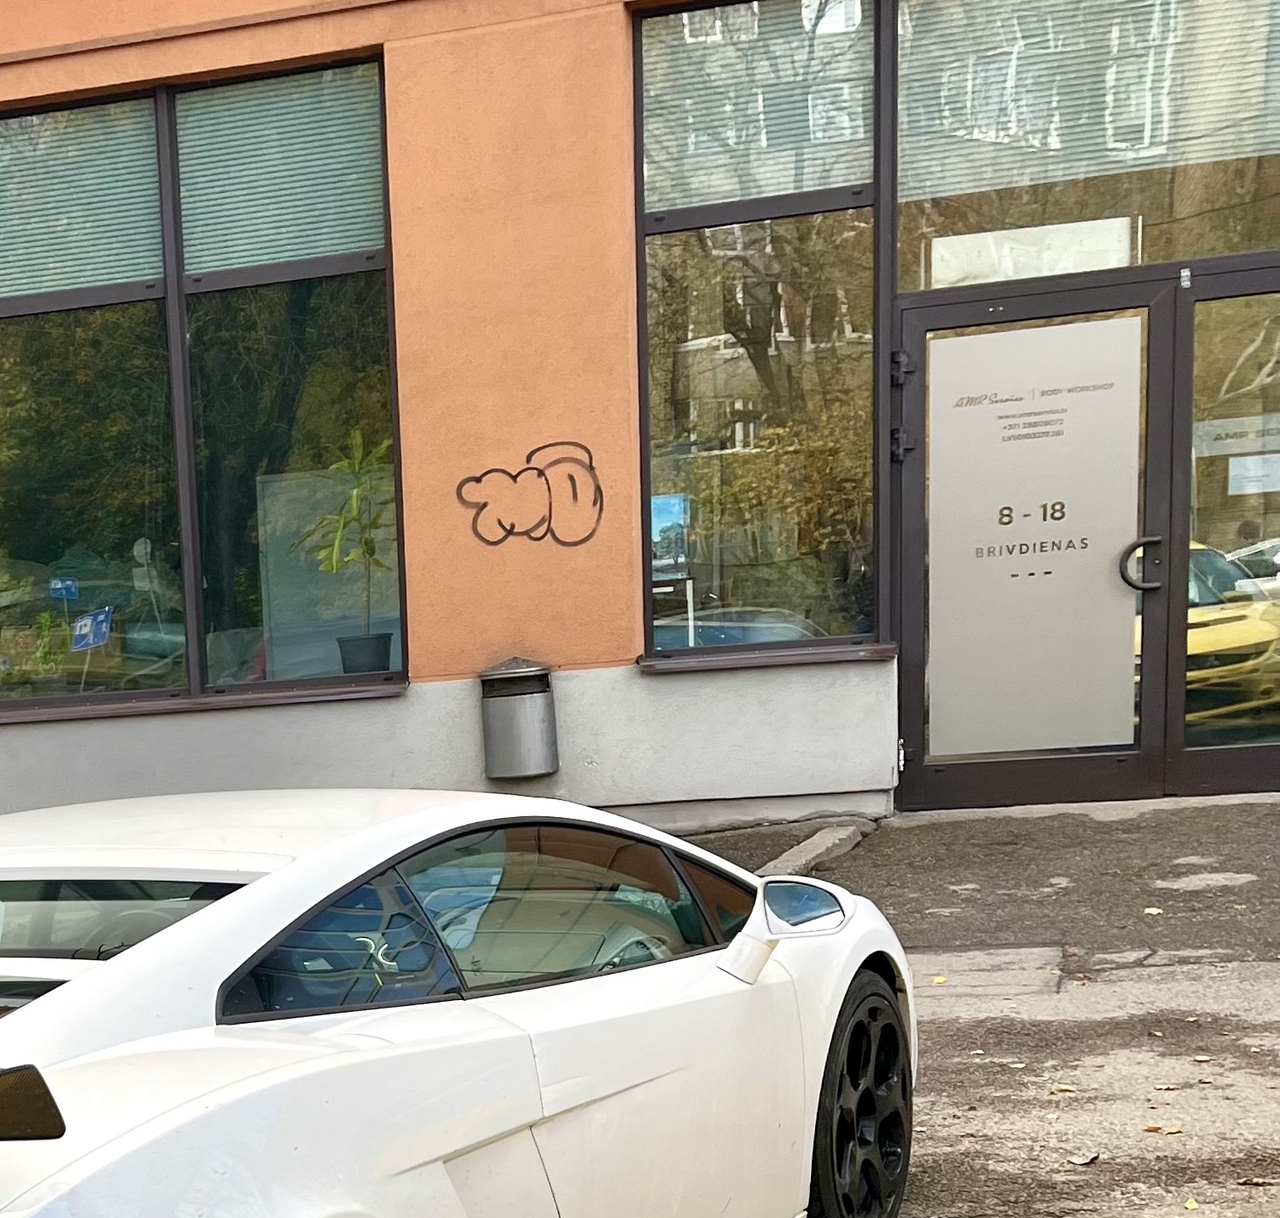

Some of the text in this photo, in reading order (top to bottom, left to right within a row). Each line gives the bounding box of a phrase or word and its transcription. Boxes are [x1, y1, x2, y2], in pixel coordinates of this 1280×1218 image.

[998, 506, 1014, 526] 8
[1040, 501, 1066, 522] 18
[975, 537, 1089, 559] BRIVDIENAS
